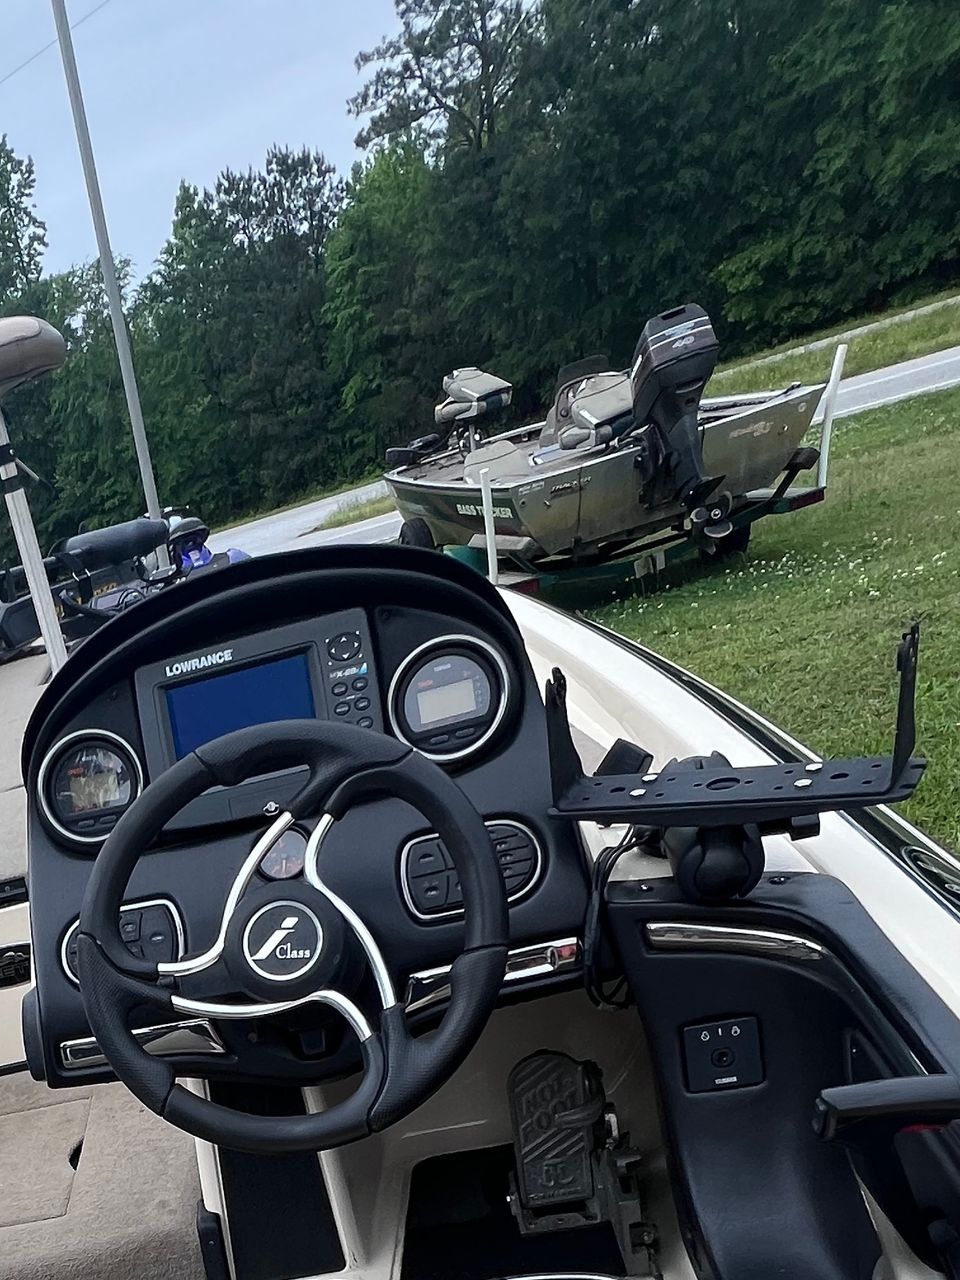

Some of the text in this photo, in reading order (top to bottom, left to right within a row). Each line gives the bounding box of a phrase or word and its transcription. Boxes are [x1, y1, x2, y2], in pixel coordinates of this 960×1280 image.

[456, 503, 513, 518] BASS TCKER
[165, 649, 234, 677] LOWRANCE
[276, 942, 311, 959] Class
